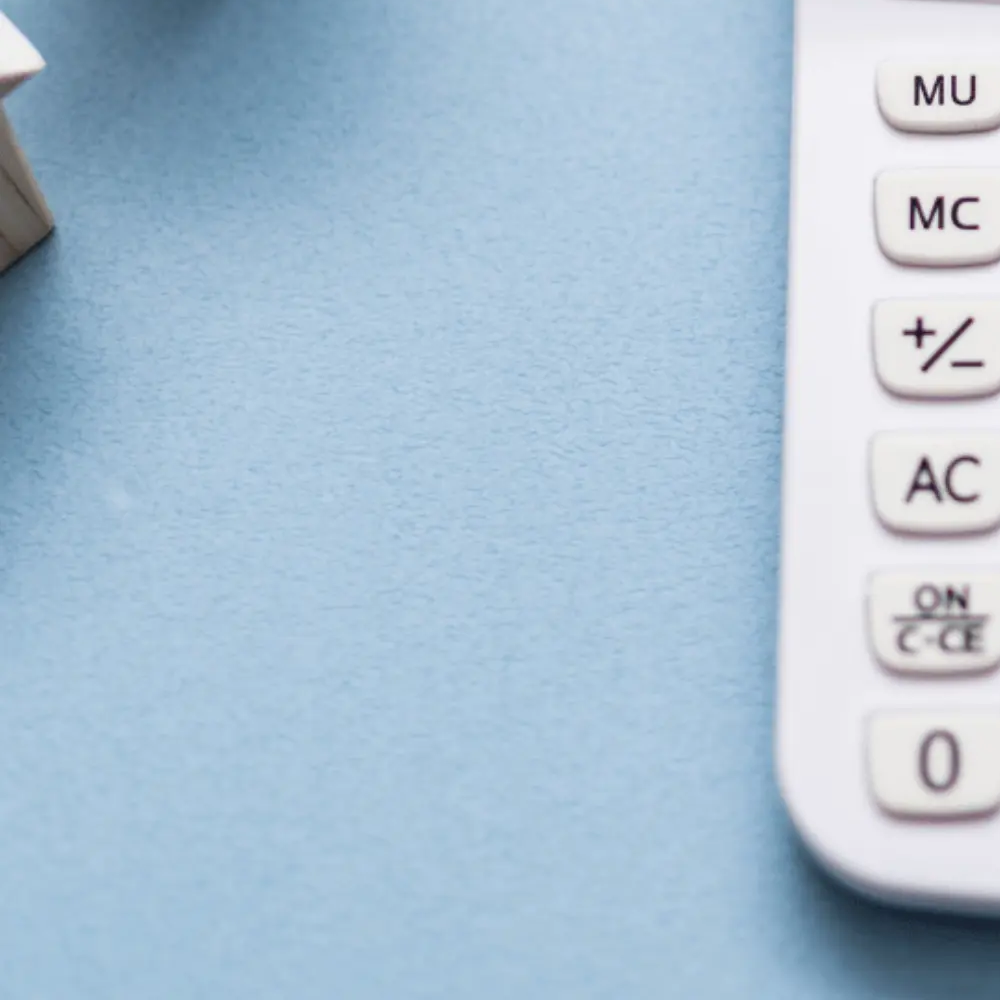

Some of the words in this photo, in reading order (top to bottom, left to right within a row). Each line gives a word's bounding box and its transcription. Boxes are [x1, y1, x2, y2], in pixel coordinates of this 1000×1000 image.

[913, 74, 978, 106] MU
[908, 195, 981, 231] MC
[904, 453, 982, 504] AC
[913, 583, 970, 613] ON
[918, 729, 961, 793] 0
